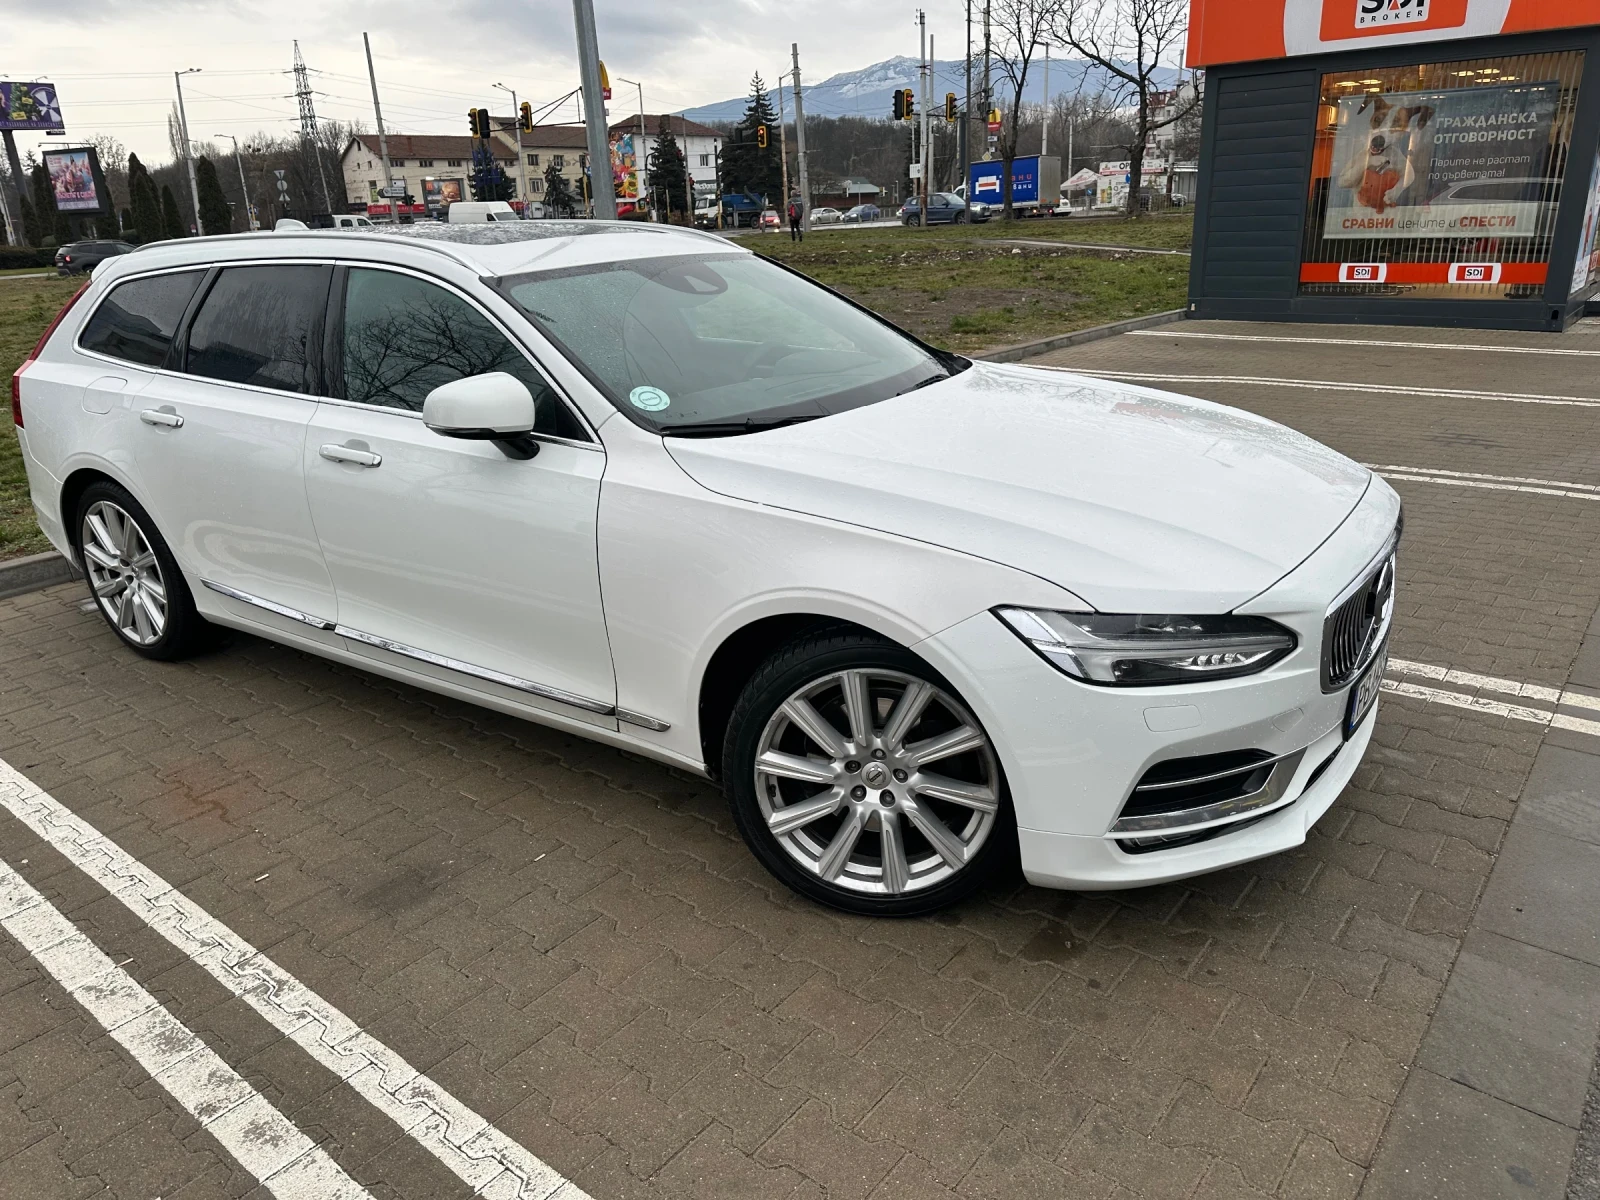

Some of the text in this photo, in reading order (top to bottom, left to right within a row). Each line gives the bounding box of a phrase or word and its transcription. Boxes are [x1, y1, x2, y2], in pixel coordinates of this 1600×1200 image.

[1360, 10, 1423, 23] BROKER
[1436, 112, 1538, 128] ГРАЖДАНСКА
[1433, 129, 1536, 144] ОТГОВОРНОСТ
[1430, 155, 1530, 168] Парите не растат
[1428, 168, 1506, 181] по дърветата!
[1342, 215, 1517, 230] СРАВНИ цените и СПЕСТИ
[1355, 268, 1370, 276] SDI
[1466, 268, 1483, 277] SDI
